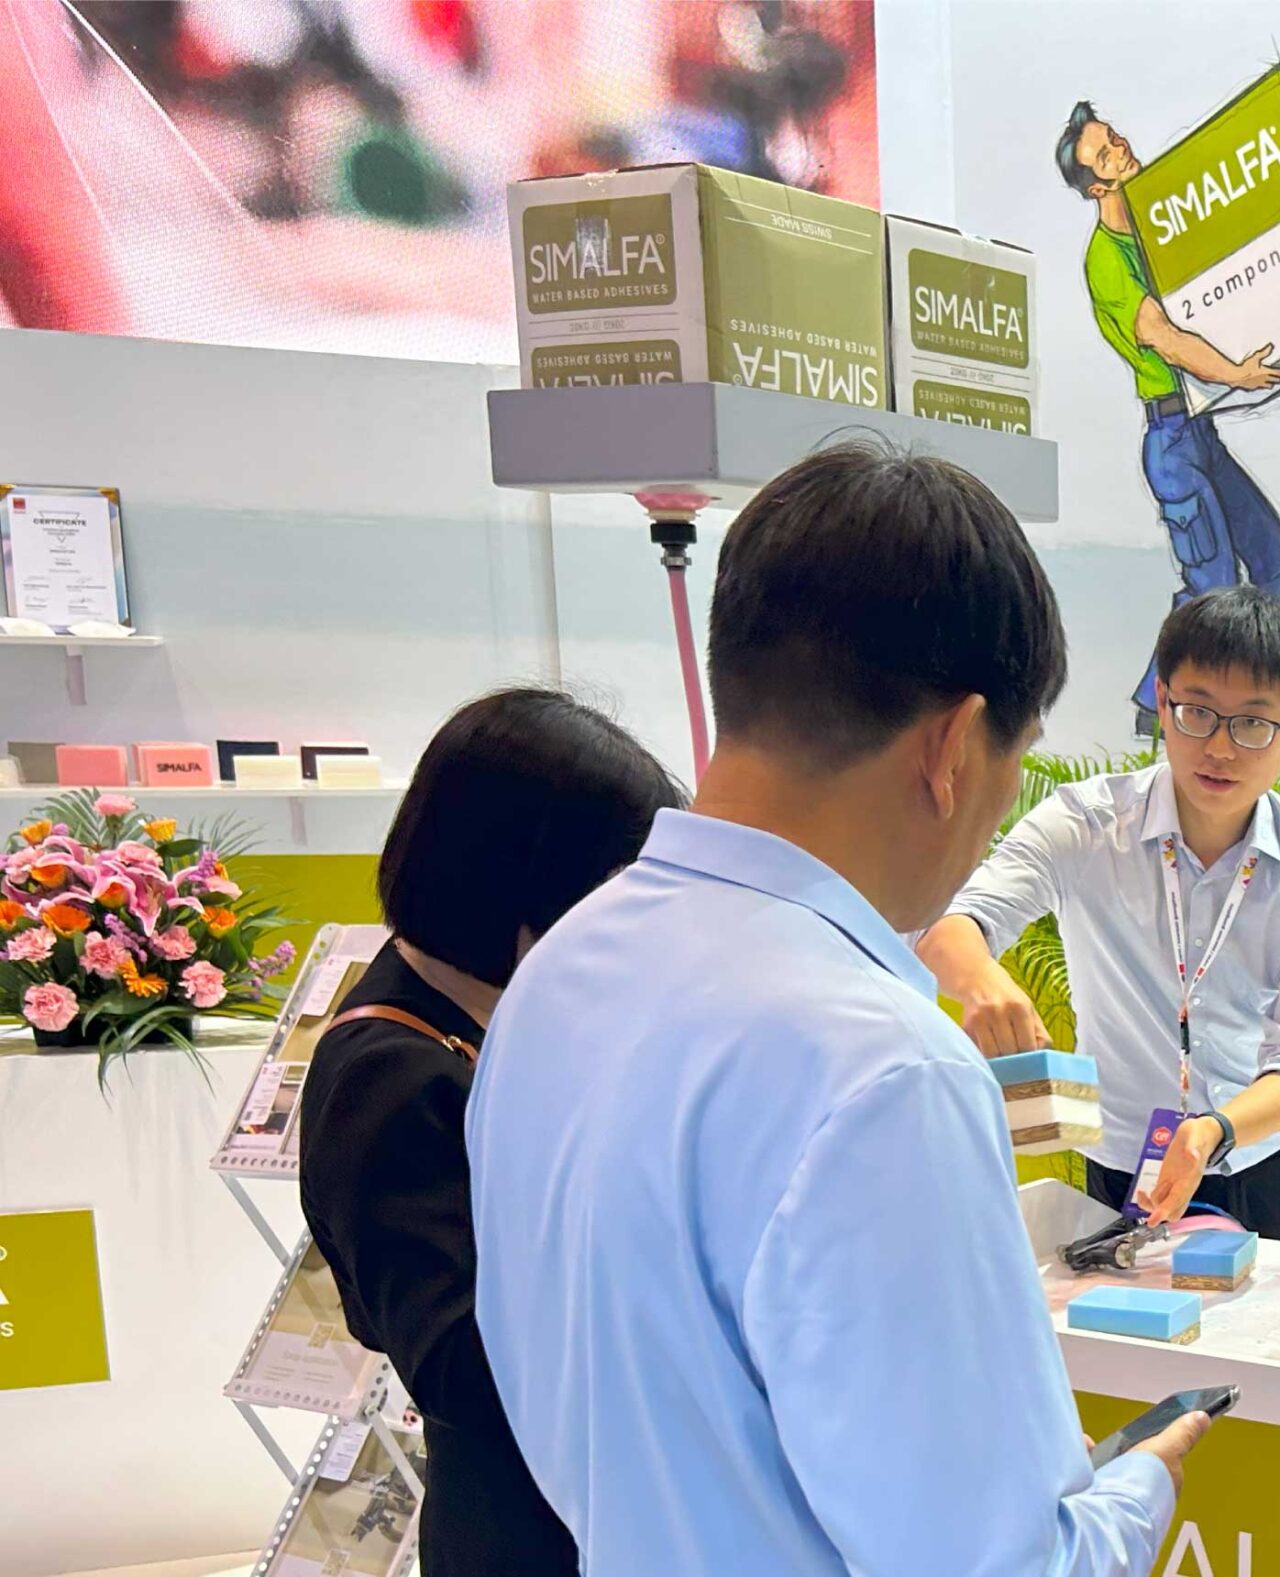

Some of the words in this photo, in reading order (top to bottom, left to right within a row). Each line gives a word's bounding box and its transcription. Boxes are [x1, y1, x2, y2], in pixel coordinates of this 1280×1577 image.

[771, 214, 801, 231] MADE
[532, 289, 563, 304] WATER
[567, 287, 600, 300] BASED
[604, 283, 669, 298] ADHESIVES
[1181, 299, 1195, 320] 2
[730, 318, 802, 342] ADHESIVES
[807, 333, 841, 350] BASED
[844, 340, 878, 357] WATER
[536, 355, 590, 369] ADHESIVES
[594, 352, 629, 365] BASED
[635, 351, 673, 364] WATER
[33, 518, 87, 527] CERTIFICATE
[156, 762, 202, 773] SIMALFA
